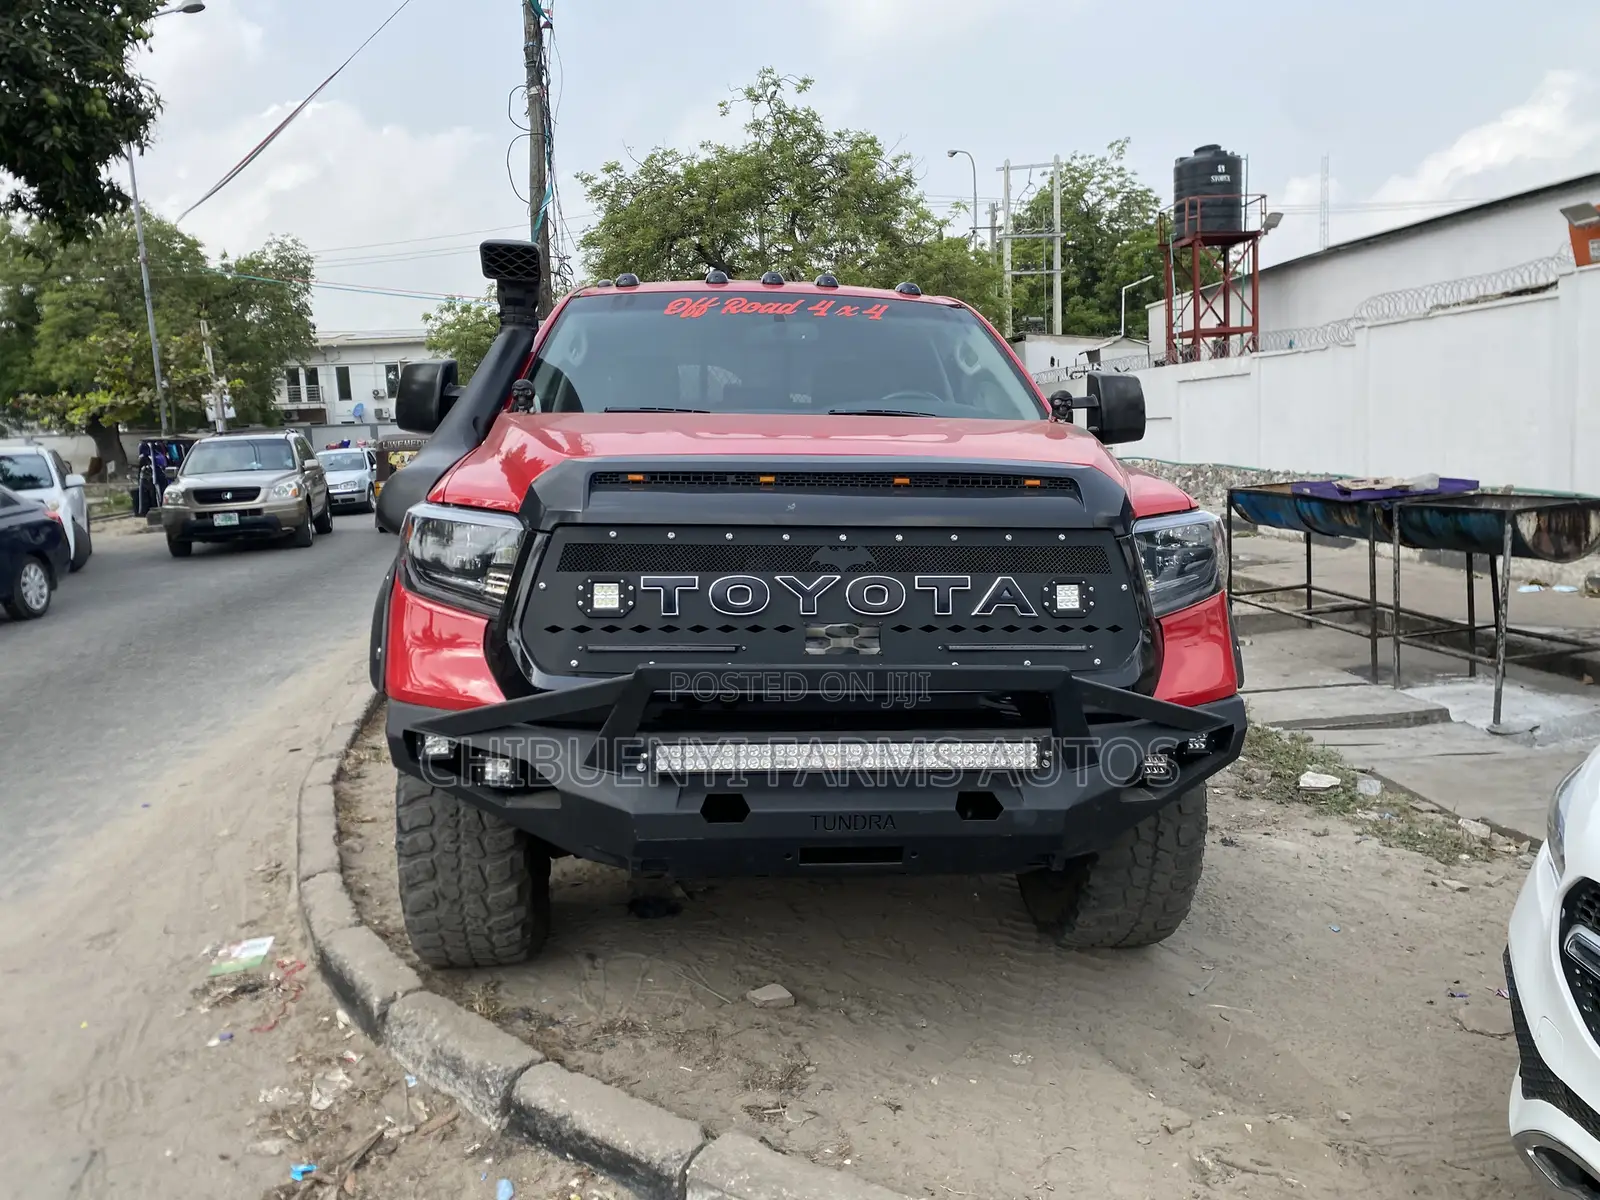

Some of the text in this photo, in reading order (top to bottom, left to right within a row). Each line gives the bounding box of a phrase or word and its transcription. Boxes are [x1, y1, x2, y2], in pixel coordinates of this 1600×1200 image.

[664, 297, 720, 319] Off
[721, 297, 805, 316] Road
[640, 575, 1039, 617] TOYOTA
[809, 814, 897, 831] TUNDRA
